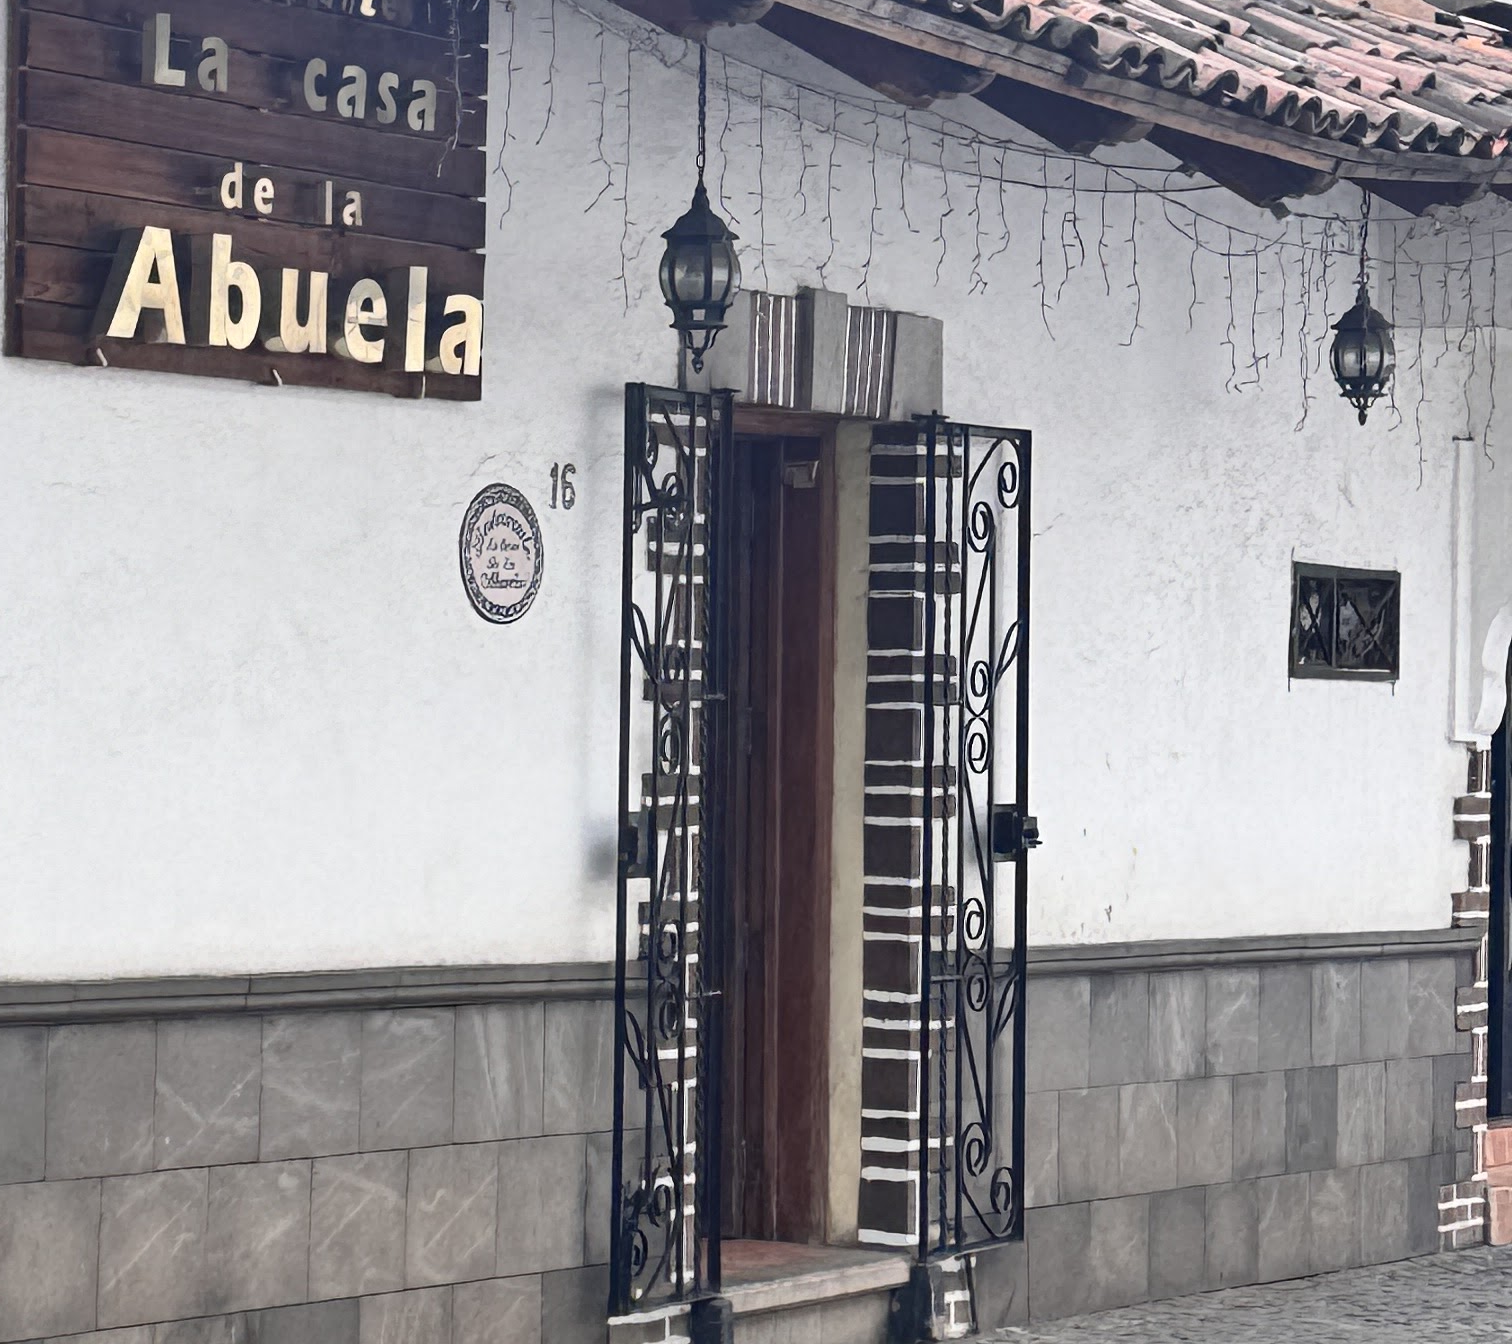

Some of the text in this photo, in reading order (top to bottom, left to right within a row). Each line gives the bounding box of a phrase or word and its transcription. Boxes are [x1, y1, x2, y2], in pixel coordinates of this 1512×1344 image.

[153, 13, 437, 131] La casa
[220, 162, 363, 226] de la
[106, 225, 484, 376] Abuela
[549, 462, 577, 510] 16
